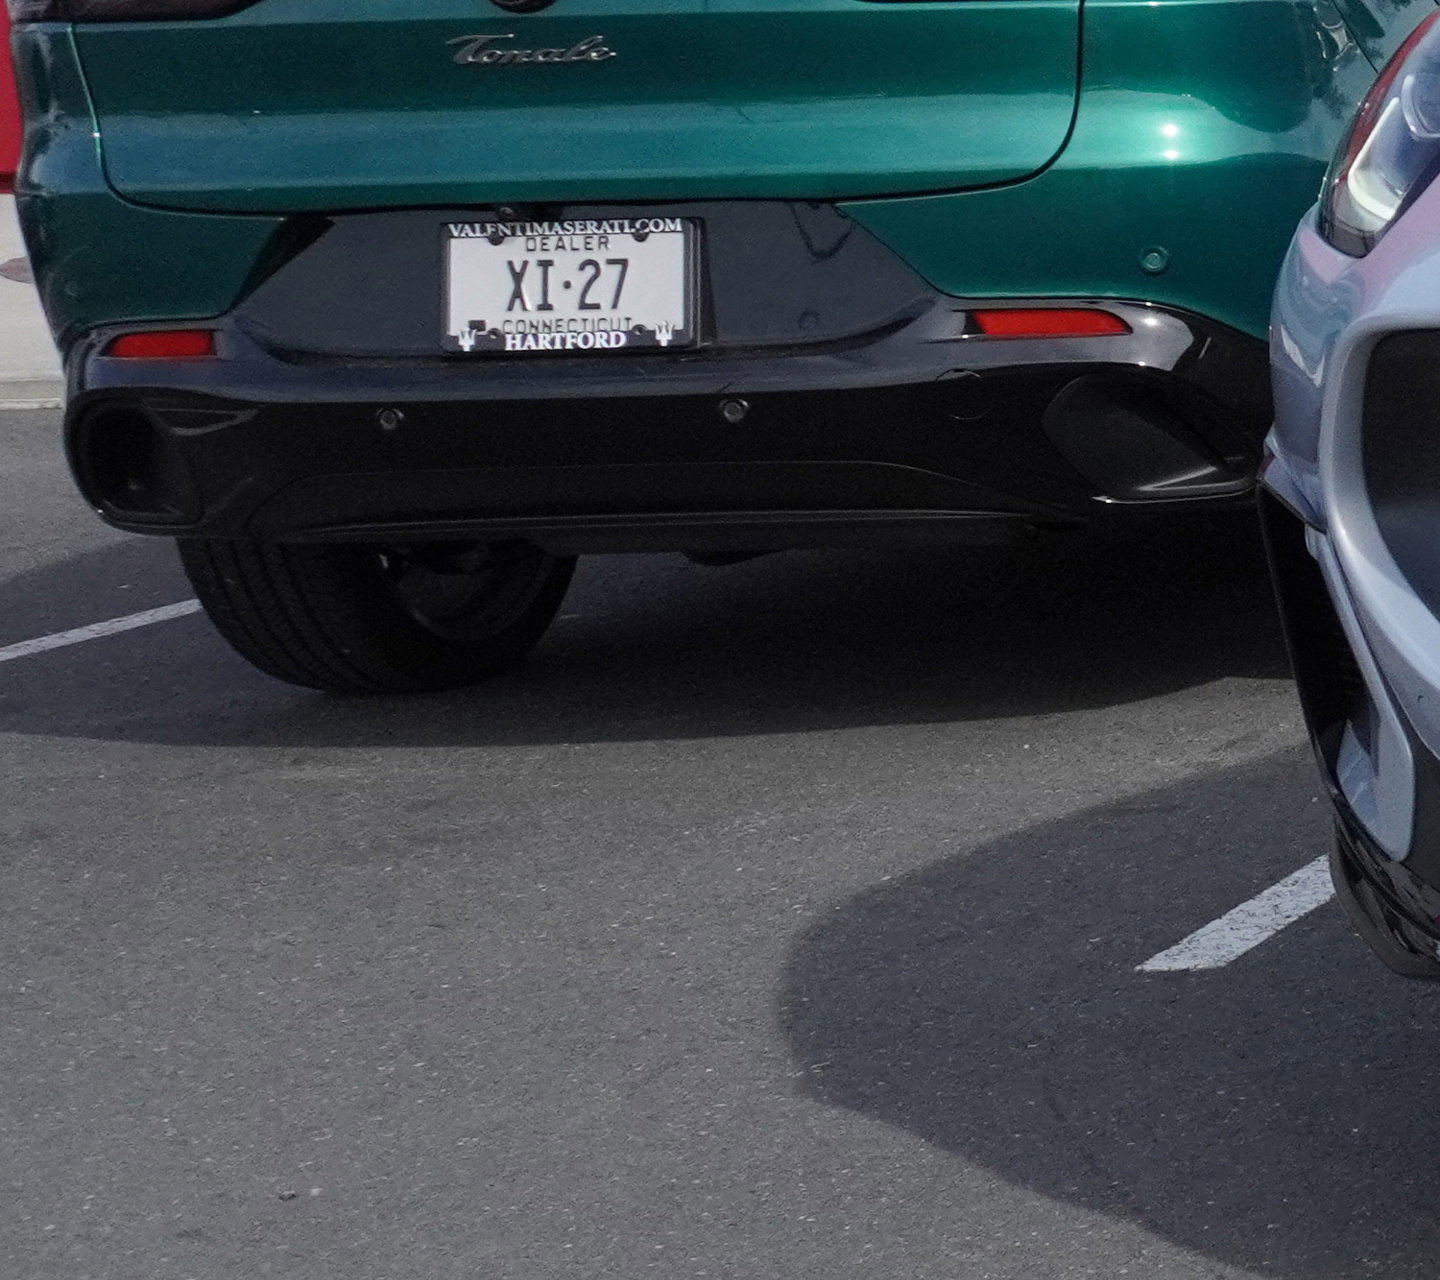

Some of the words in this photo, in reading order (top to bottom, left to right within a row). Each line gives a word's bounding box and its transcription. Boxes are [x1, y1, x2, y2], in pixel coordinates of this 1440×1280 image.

[446, 33, 616, 65] Tonale
[526, 235, 610, 252] DEALER
[502, 317, 633, 333] CONNECTICUT
[504, 331, 628, 351] HARTFORD
